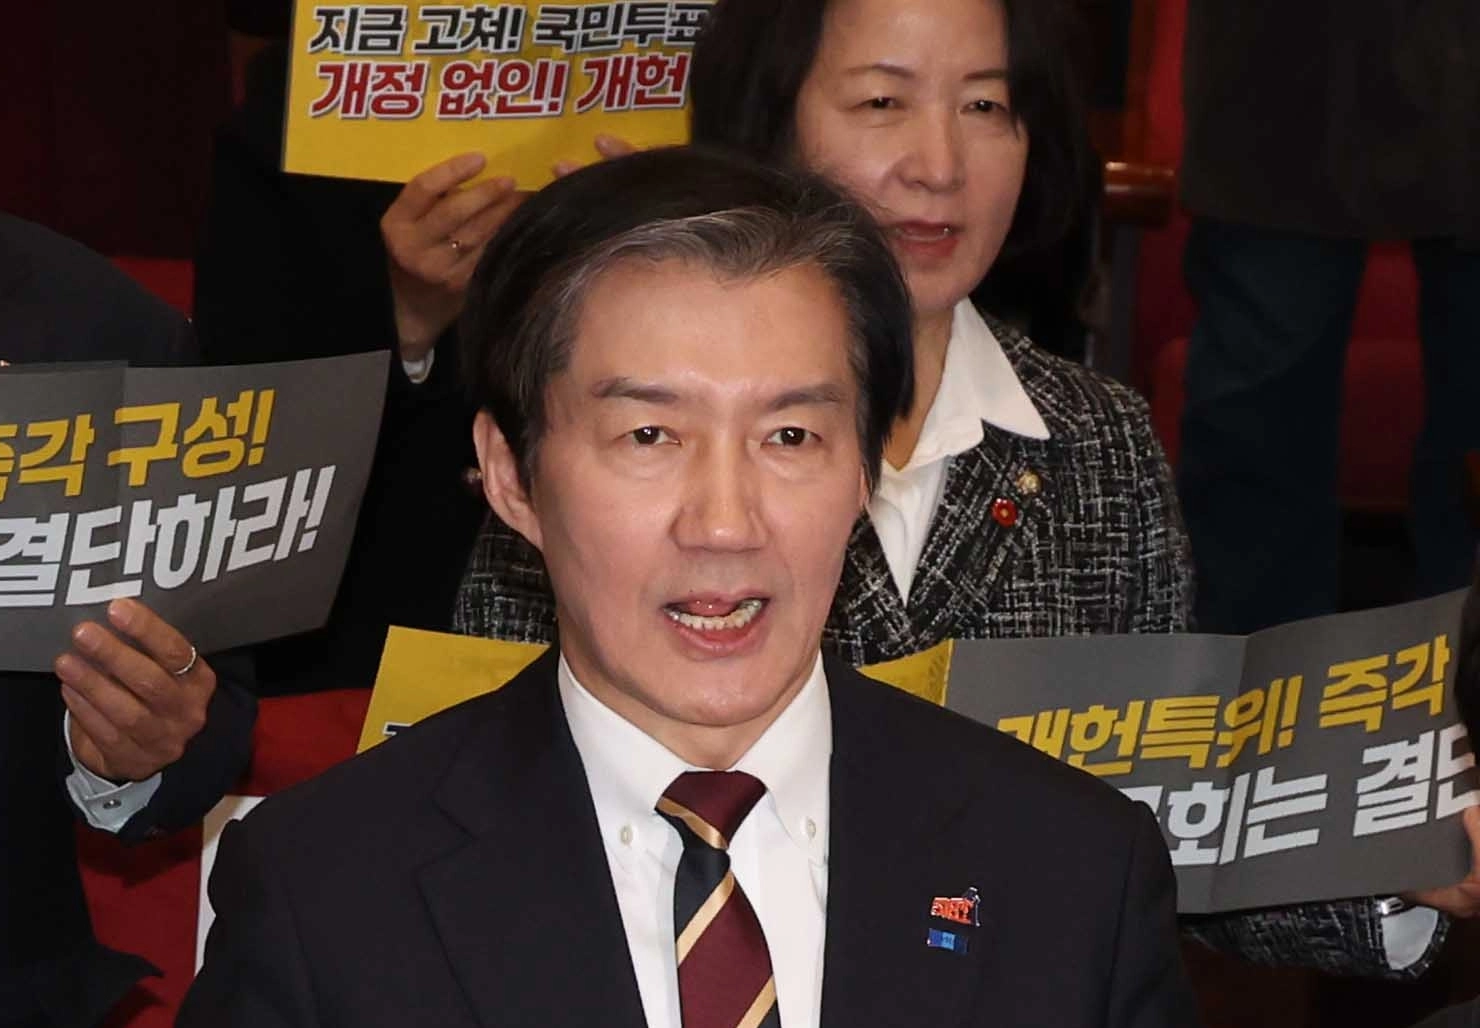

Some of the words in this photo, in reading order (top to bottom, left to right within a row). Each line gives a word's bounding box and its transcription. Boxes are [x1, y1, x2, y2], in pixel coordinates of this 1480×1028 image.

[308, 4, 408, 55] 지금
[414, 3, 528, 54] 고쳐!
[309, 60, 426, 119] 개정
[437, 57, 569, 119] 없인!
[576, 52, 692, 114] 개헌
[107, 390, 275, 486] 구성!
[1320, 634, 1450, 733] 즉각
[1118, 766, 1328, 866] 회는
